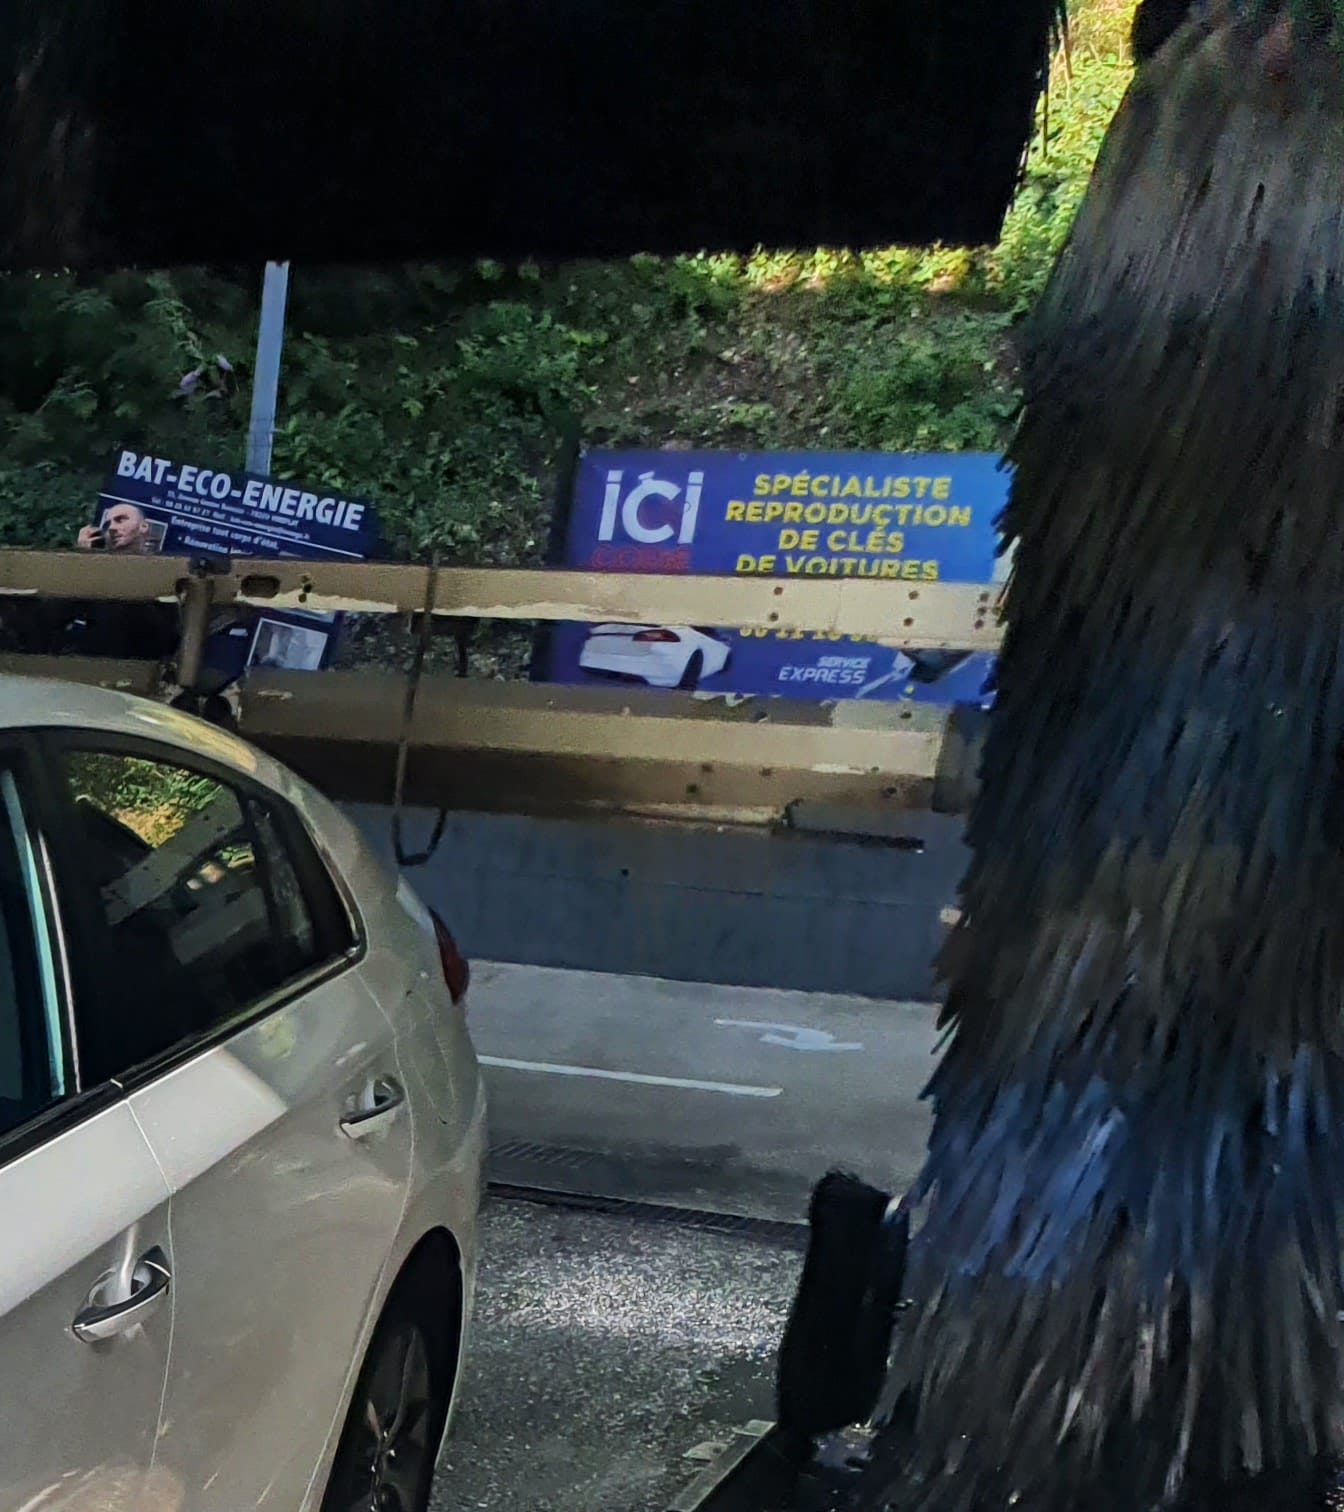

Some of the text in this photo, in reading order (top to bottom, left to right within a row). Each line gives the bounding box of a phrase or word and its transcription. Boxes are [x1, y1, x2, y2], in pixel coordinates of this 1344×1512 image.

[117, 451, 365, 531] BAT-ECO-ENERGIE
[753, 469, 953, 500] SPÉCIALISTE
[725, 500, 973, 527] REPRODUCTION
[778, 525, 905, 554] DE CLÉS
[736, 556, 940, 581] DE VOITURES
[778, 666, 867, 684] EXPRESS
